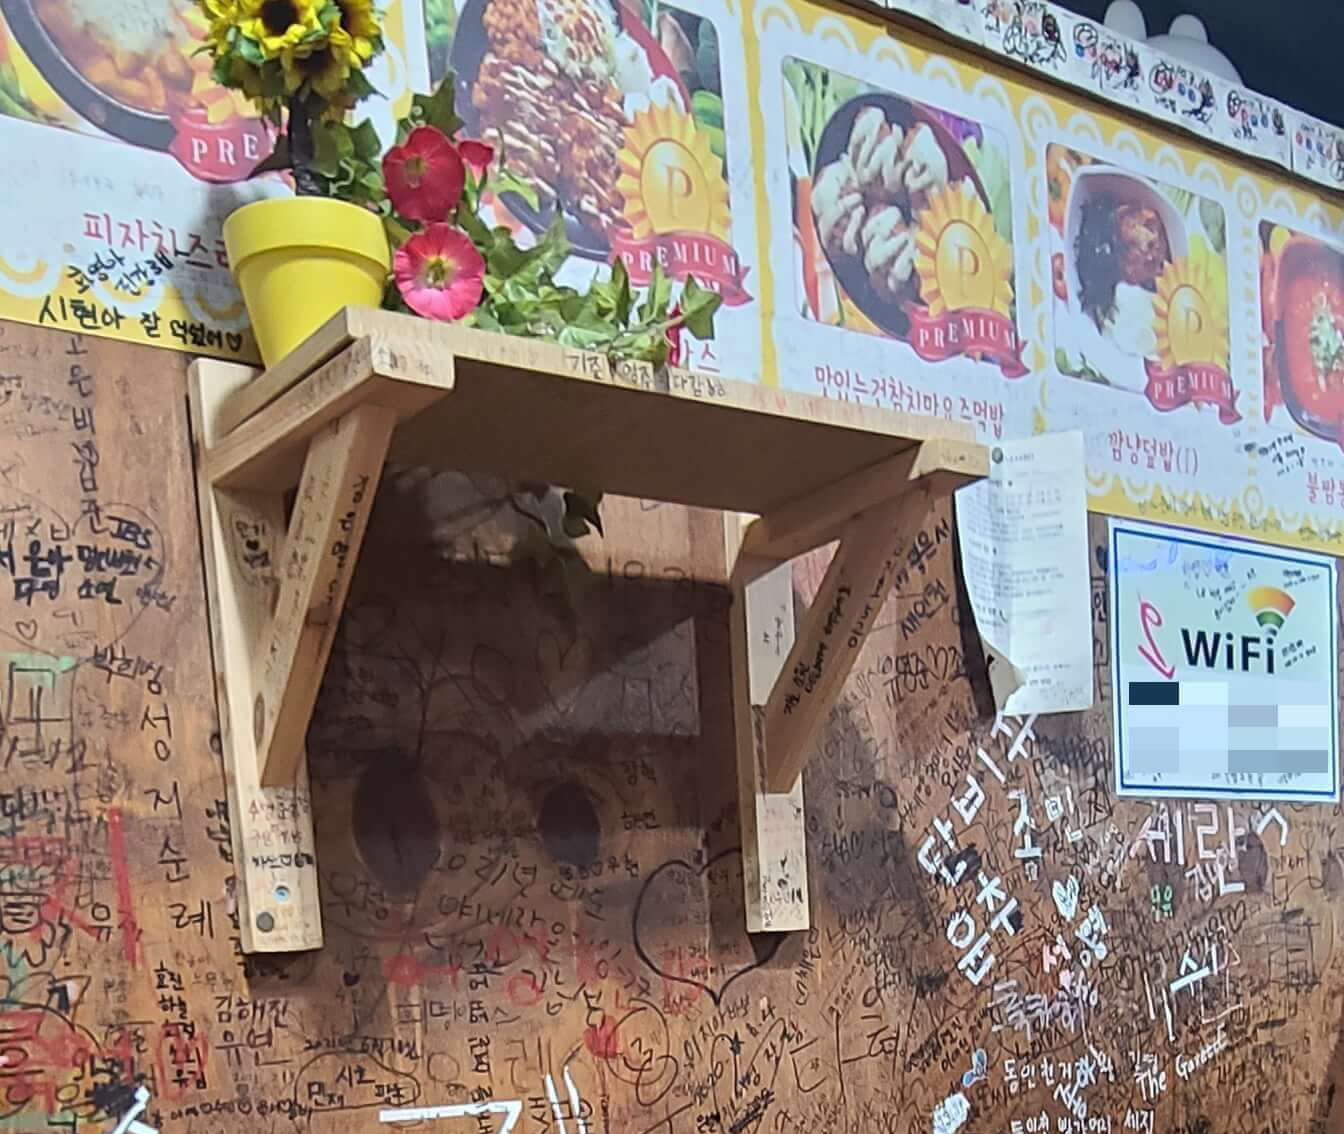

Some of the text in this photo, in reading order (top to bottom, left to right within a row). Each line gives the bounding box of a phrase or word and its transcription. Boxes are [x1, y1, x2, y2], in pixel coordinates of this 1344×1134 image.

[620, 242, 738, 281] PREMIUM
[918, 316, 1018, 352] PREMIUM
[1152, 369, 1234, 401] PREMIUM
[1180, 628, 1275, 674] WiFi
